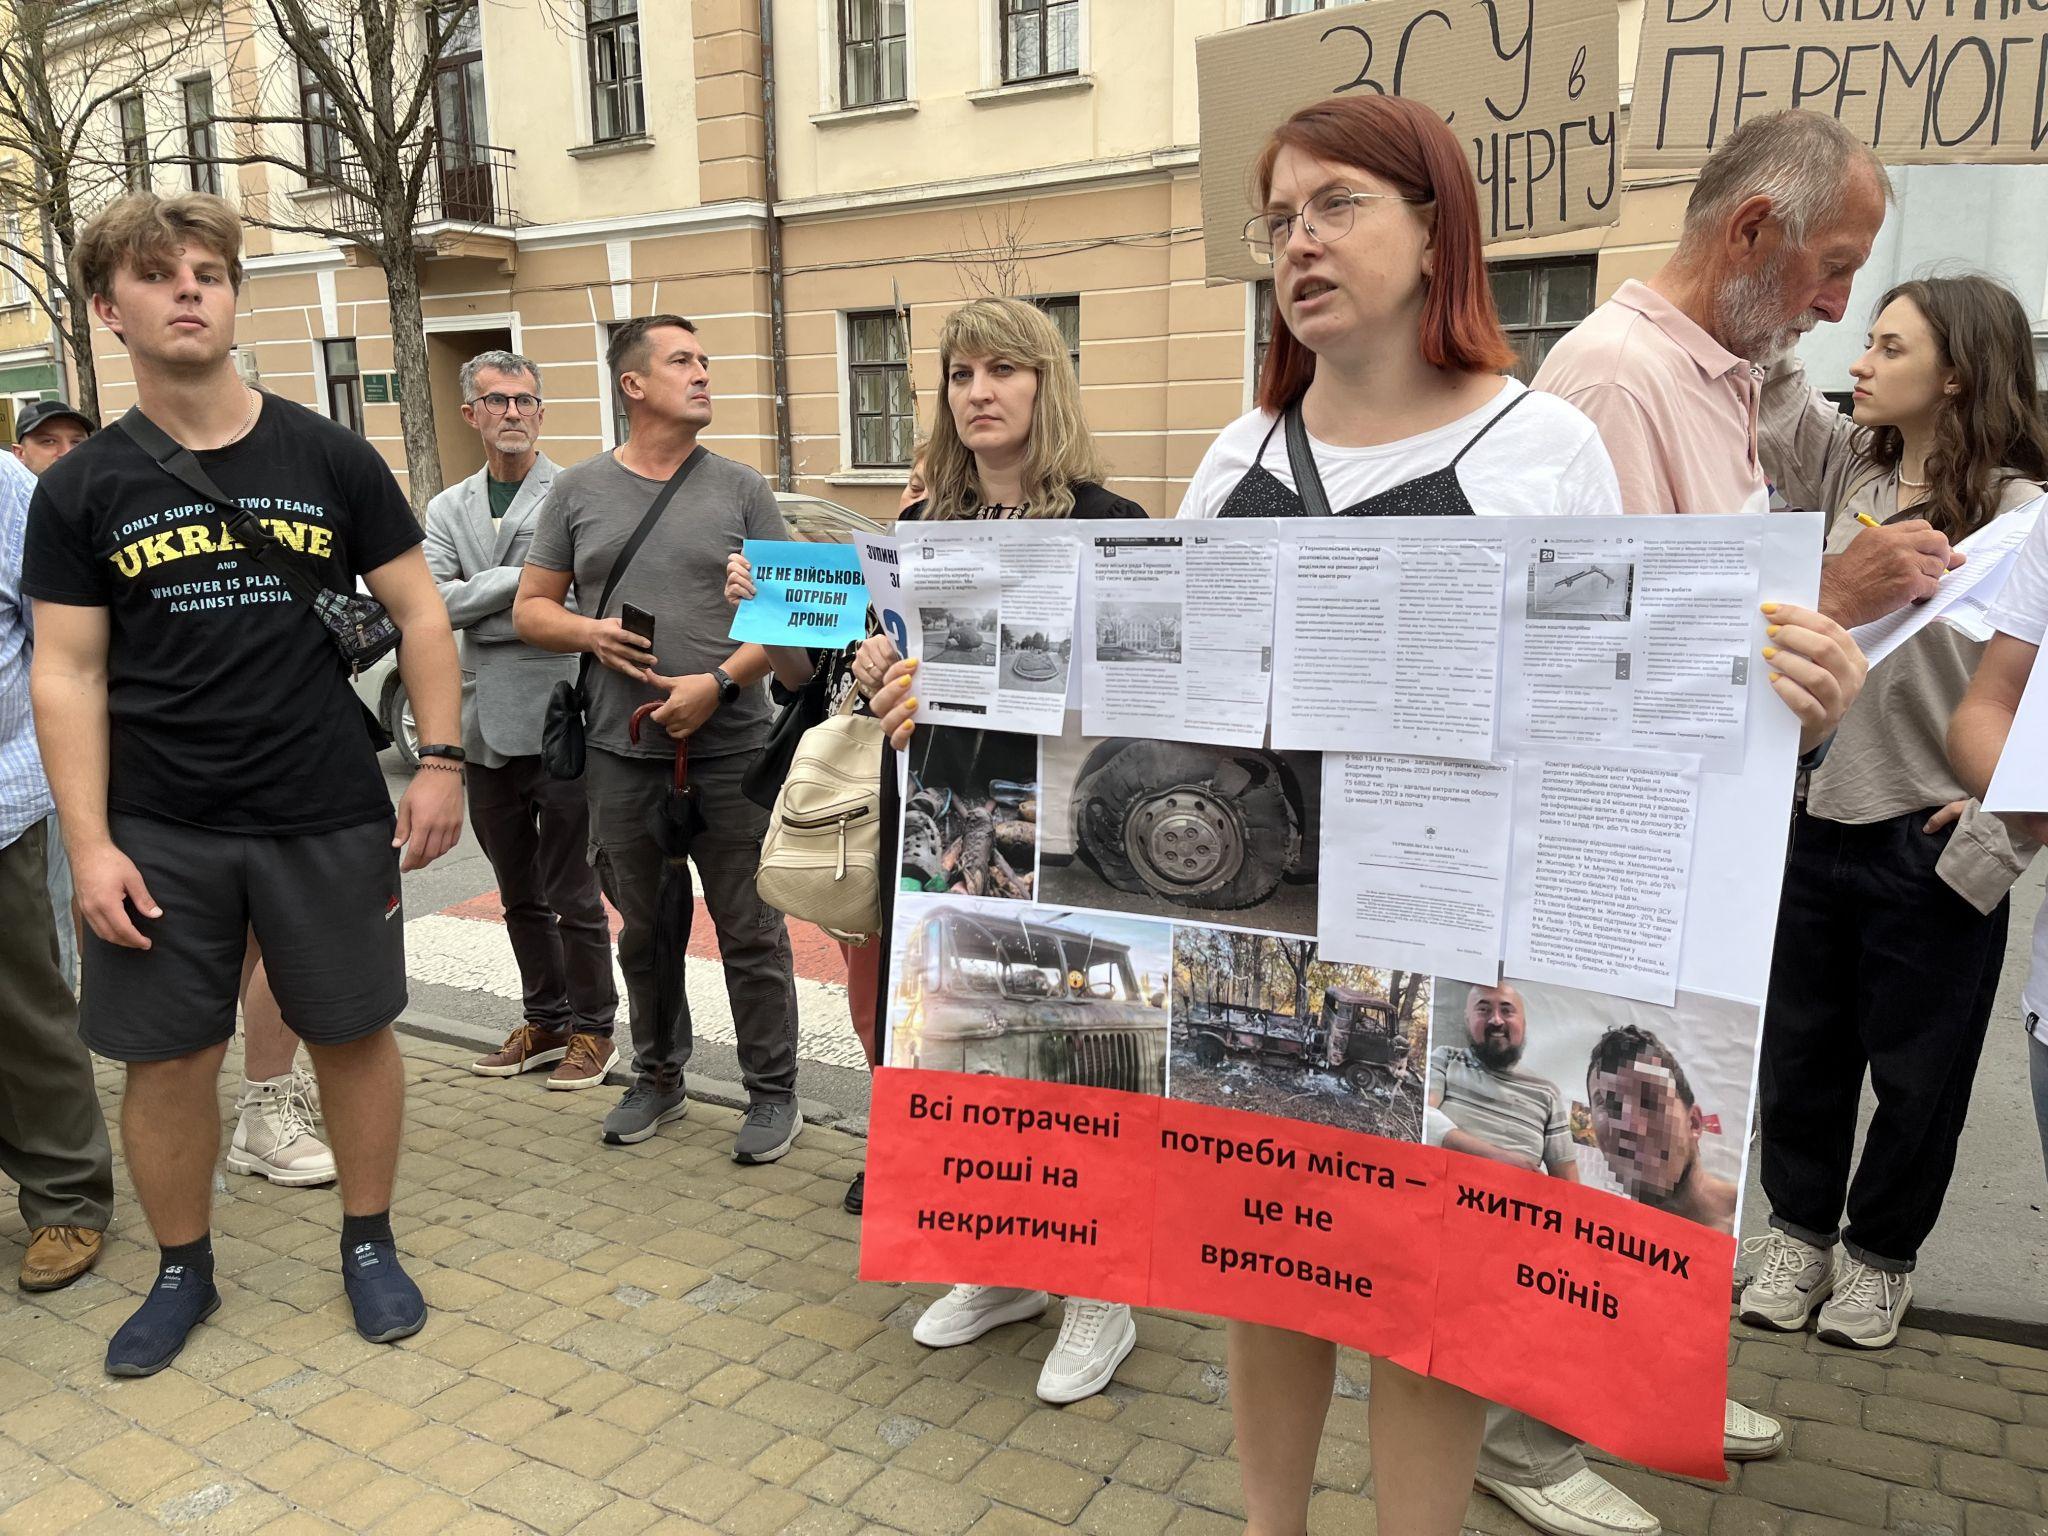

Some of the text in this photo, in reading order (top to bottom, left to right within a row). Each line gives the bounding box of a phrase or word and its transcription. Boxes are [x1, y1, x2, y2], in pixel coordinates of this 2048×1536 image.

[1568, 45, 1587, 100] в
[1473, 112, 1615, 237] ЧЕРГУ
[112, 497, 325, 541] I ONLY SUPPO TWO TEAMS
[217, 561, 238, 570] AND
[756, 566, 772, 581] ЦЕ
[776, 567, 791, 581] НЕ
[151, 574, 287, 600] WHOEVER IS PLAY
[170, 590, 293, 613] AGAINST RUSSIA
[786, 588, 848, 606] ПОТРІБНІ
[787, 612, 838, 628] ДРОНИ!
[1344, 762, 1374, 771] бюджету
[1385, 765, 1412, 773] травень
[1453, 770, 1480, 779] початку
[1640, 819, 1671, 829] допомогу
[909, 1093, 1120, 1138] Всі потрачені
[943, 1155, 1079, 1188] гроші на
[1161, 1129, 1296, 1169] потреби
[1307, 1151, 1395, 1189] міста
[917, 1209, 1098, 1246] некритичні
[1244, 1197, 1333, 1232] це не
[1456, 1185, 1691, 1280] життя наших
[1201, 1243, 1373, 1298] врятоване
[1516, 1263, 1619, 1320] воїнів
